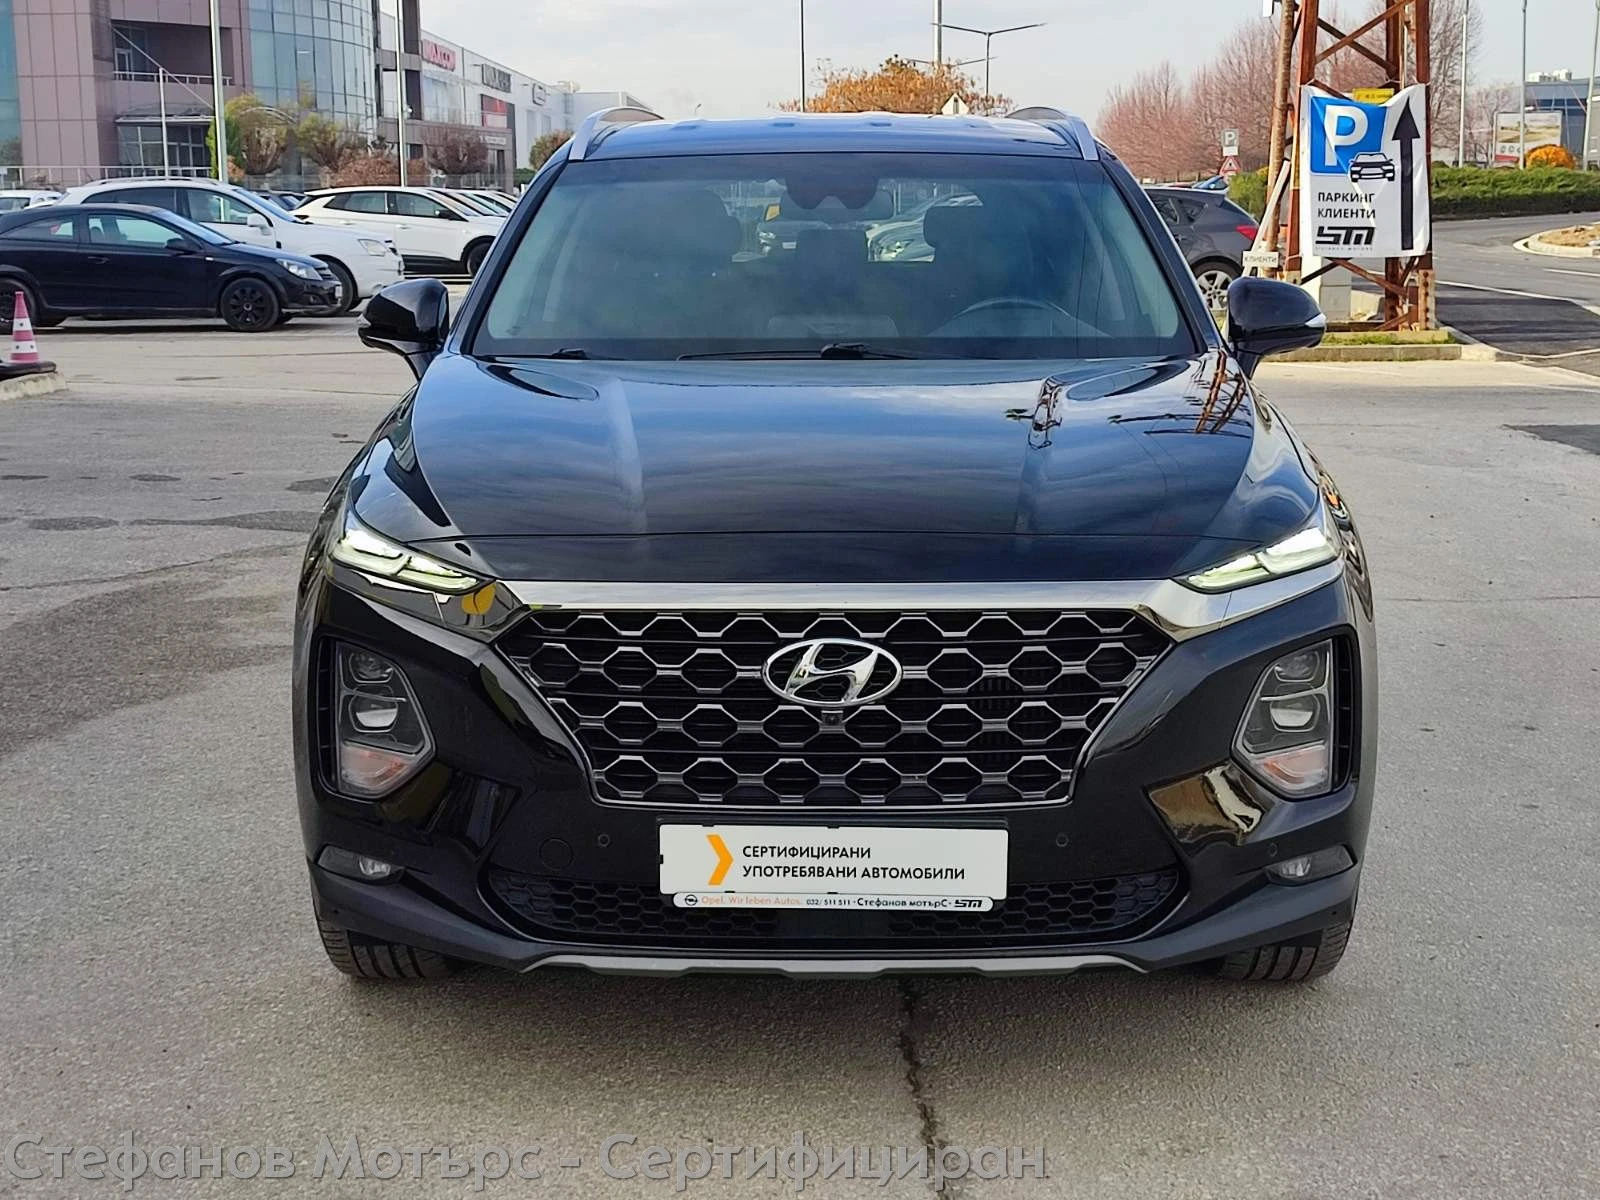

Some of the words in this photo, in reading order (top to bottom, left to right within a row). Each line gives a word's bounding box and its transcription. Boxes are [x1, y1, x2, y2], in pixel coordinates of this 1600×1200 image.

[1324, 104, 1368, 166] P
[1318, 191, 1375, 203] ПАРКИНГ
[1317, 208, 1376, 219] КЛИЕНТИ
[742, 846, 871, 859] СЕРТИФИЦИРАНИ
[742, 866, 857, 878] УПОТРЕБЯВАНИ
[861, 867, 965, 879] АВТОМОБИЛИ
[857, 897, 906, 907] Стефанов
